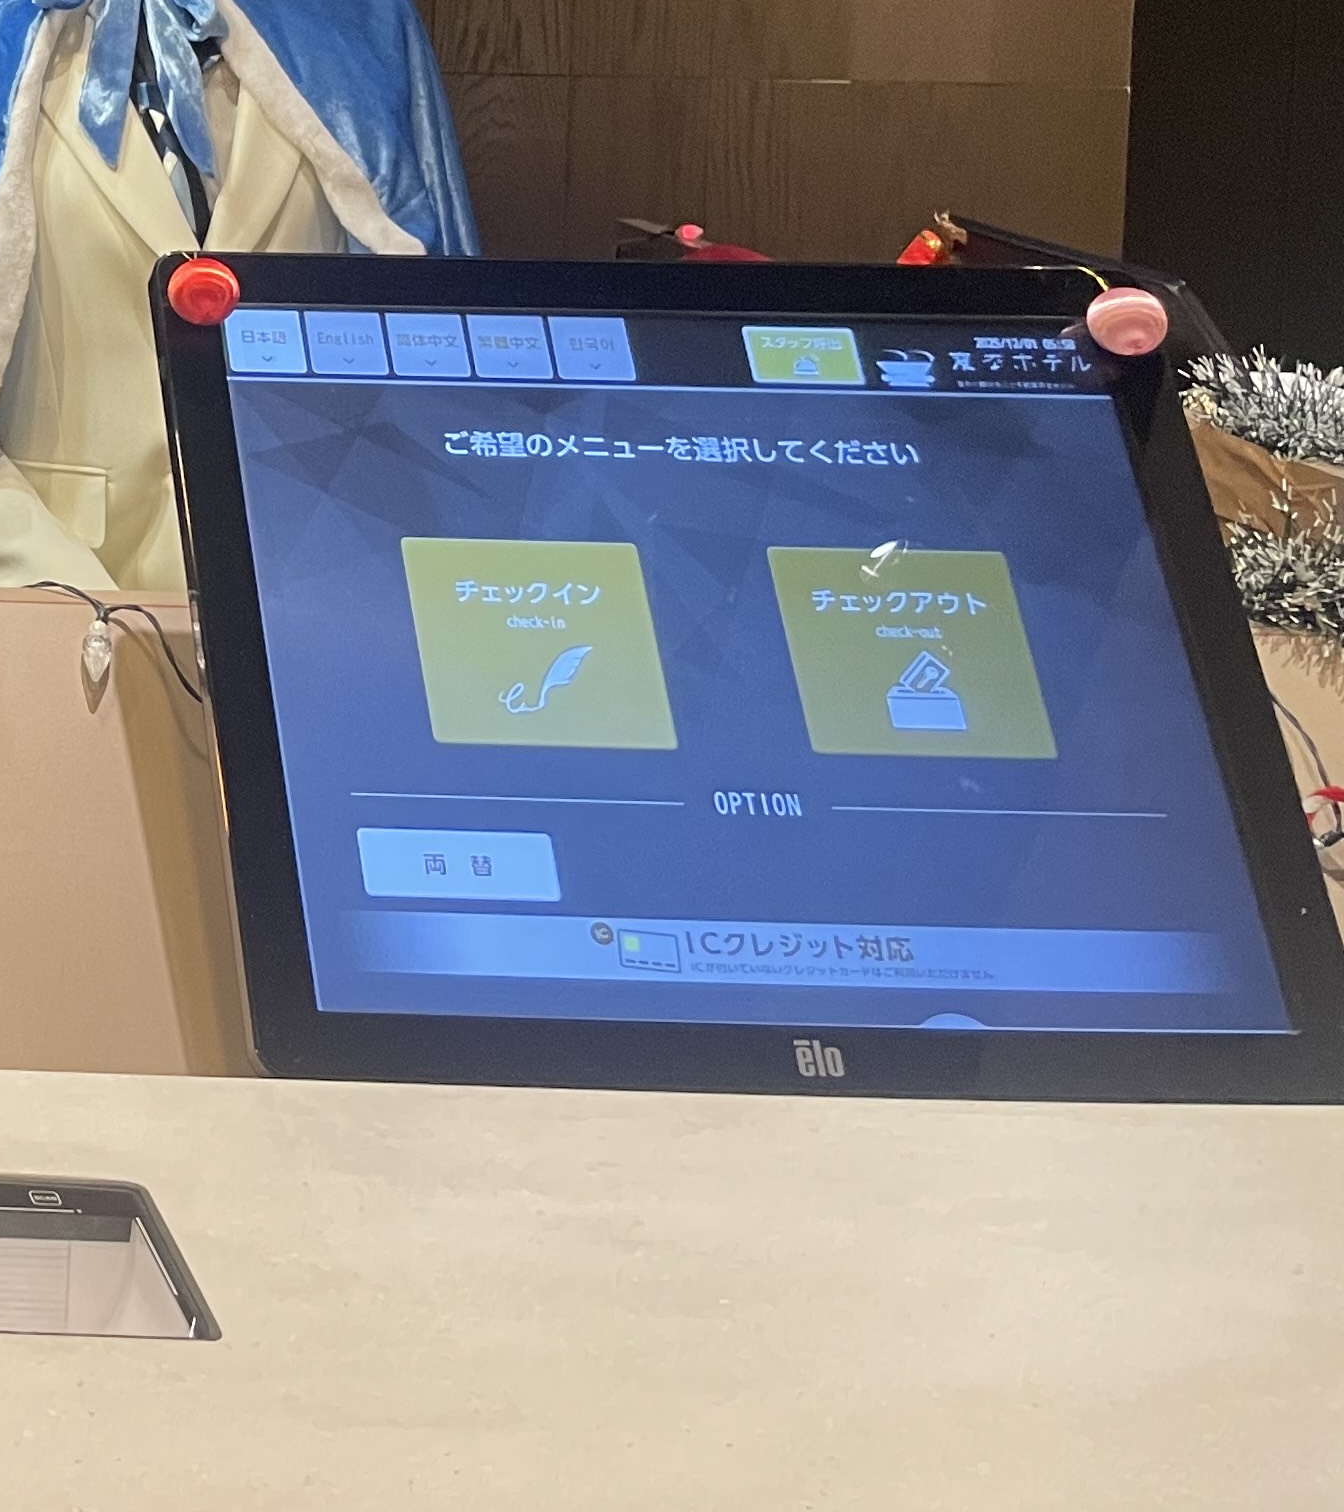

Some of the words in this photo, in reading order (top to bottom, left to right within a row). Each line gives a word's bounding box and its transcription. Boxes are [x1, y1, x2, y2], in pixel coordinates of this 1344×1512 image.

[241, 329, 287, 345] 日本語
[317, 331, 374, 348] English
[569, 337, 614, 352] 한국어
[948, 352, 1092, 374] 変なホテル
[444, 431, 920, 465] ご希望のメニューを選択してください
[455, 579, 600, 606] チェックイン
[811, 589, 987, 616] チェックアウト
[507, 614, 567, 630] check-in
[874, 624, 943, 640] check-out
[713, 790, 803, 817] OPTION
[685, 930, 915, 962] ICクレジット対応
